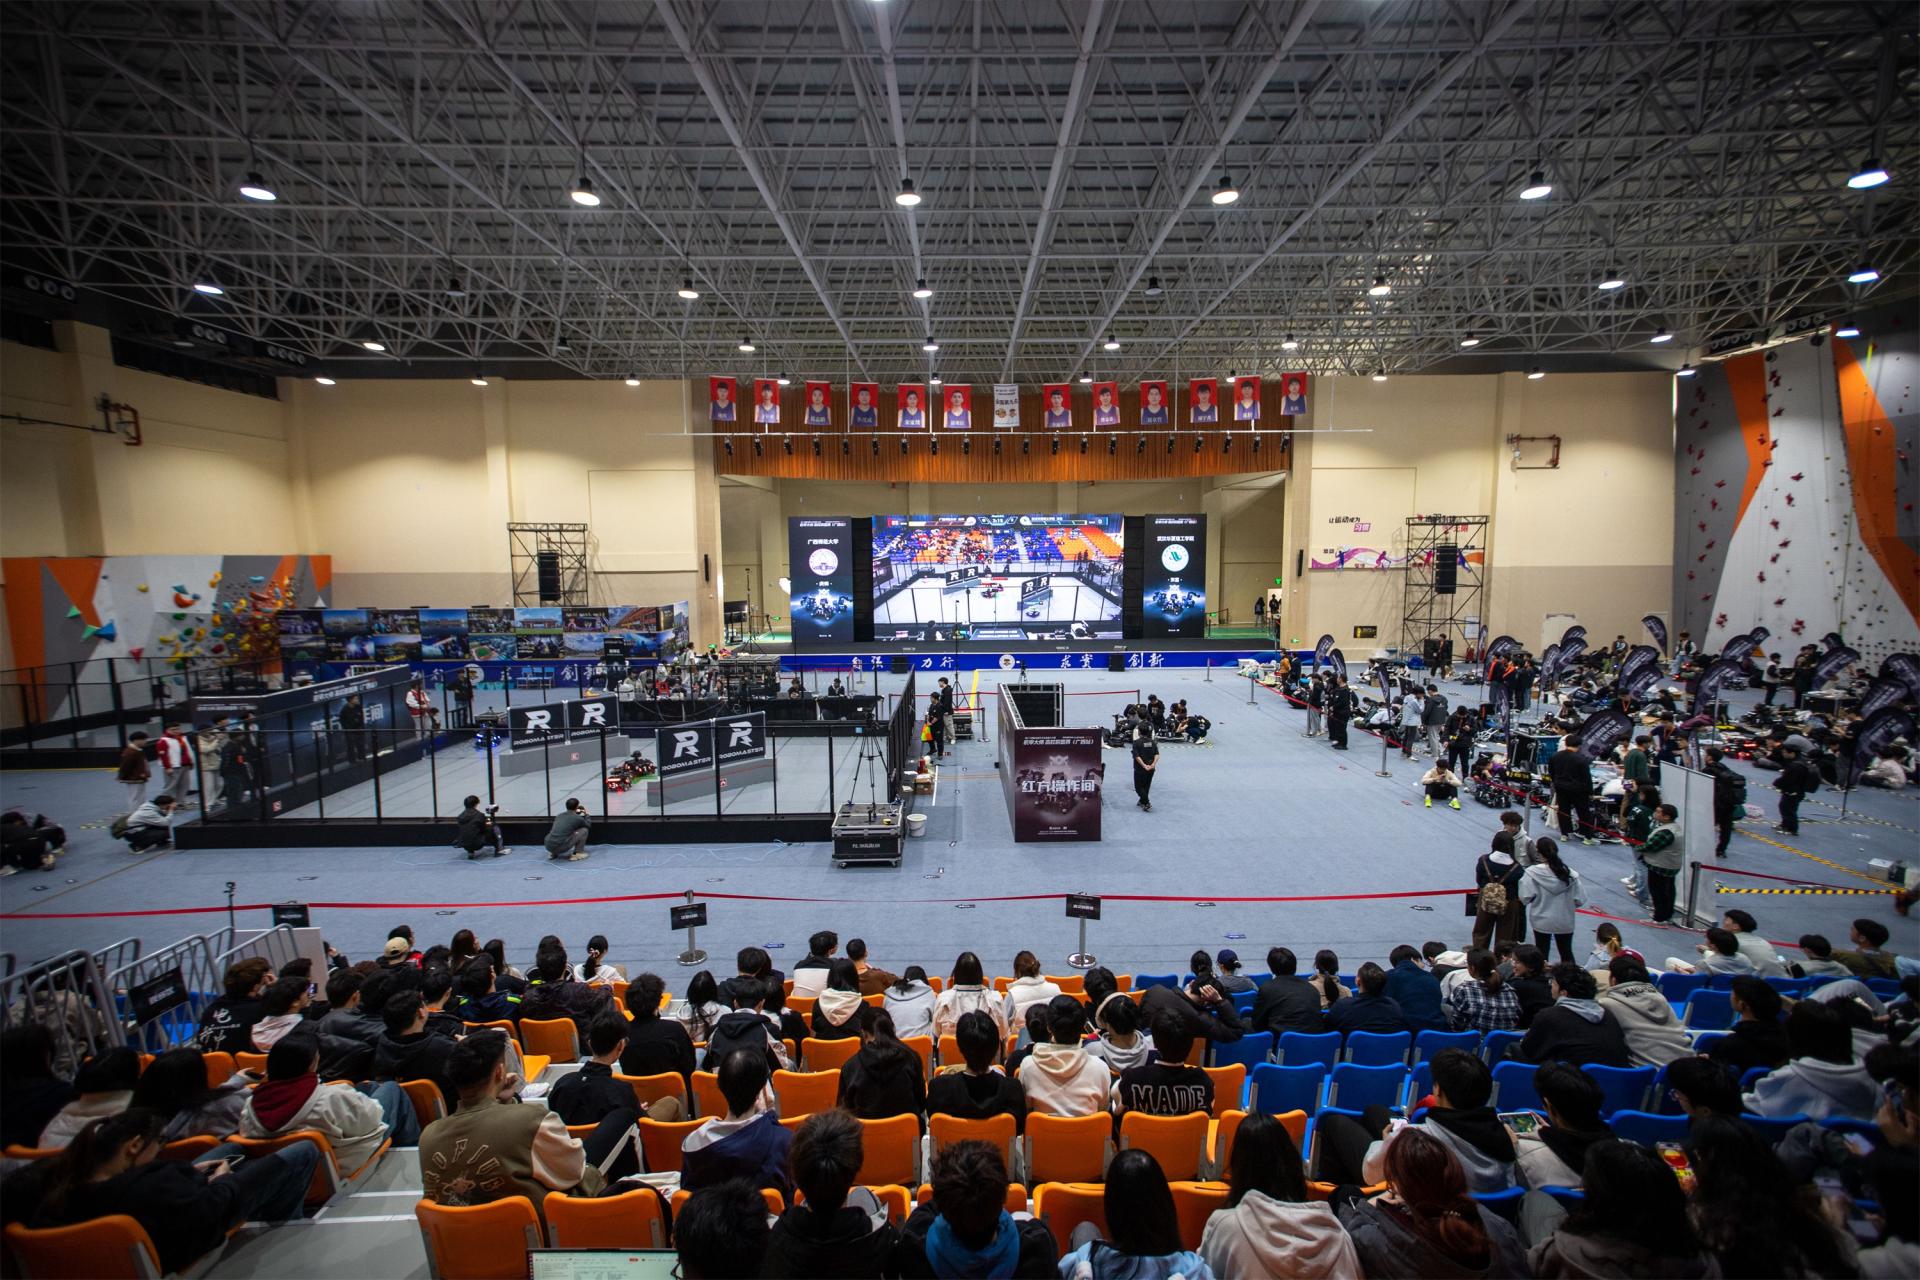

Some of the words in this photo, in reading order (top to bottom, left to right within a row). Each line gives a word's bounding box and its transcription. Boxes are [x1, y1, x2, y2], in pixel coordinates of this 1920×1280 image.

[661, 756, 712, 771] ROBOMASTER
[1022, 780, 1095, 792] 红方操作间
[1131, 1084, 1206, 1115] MADE
